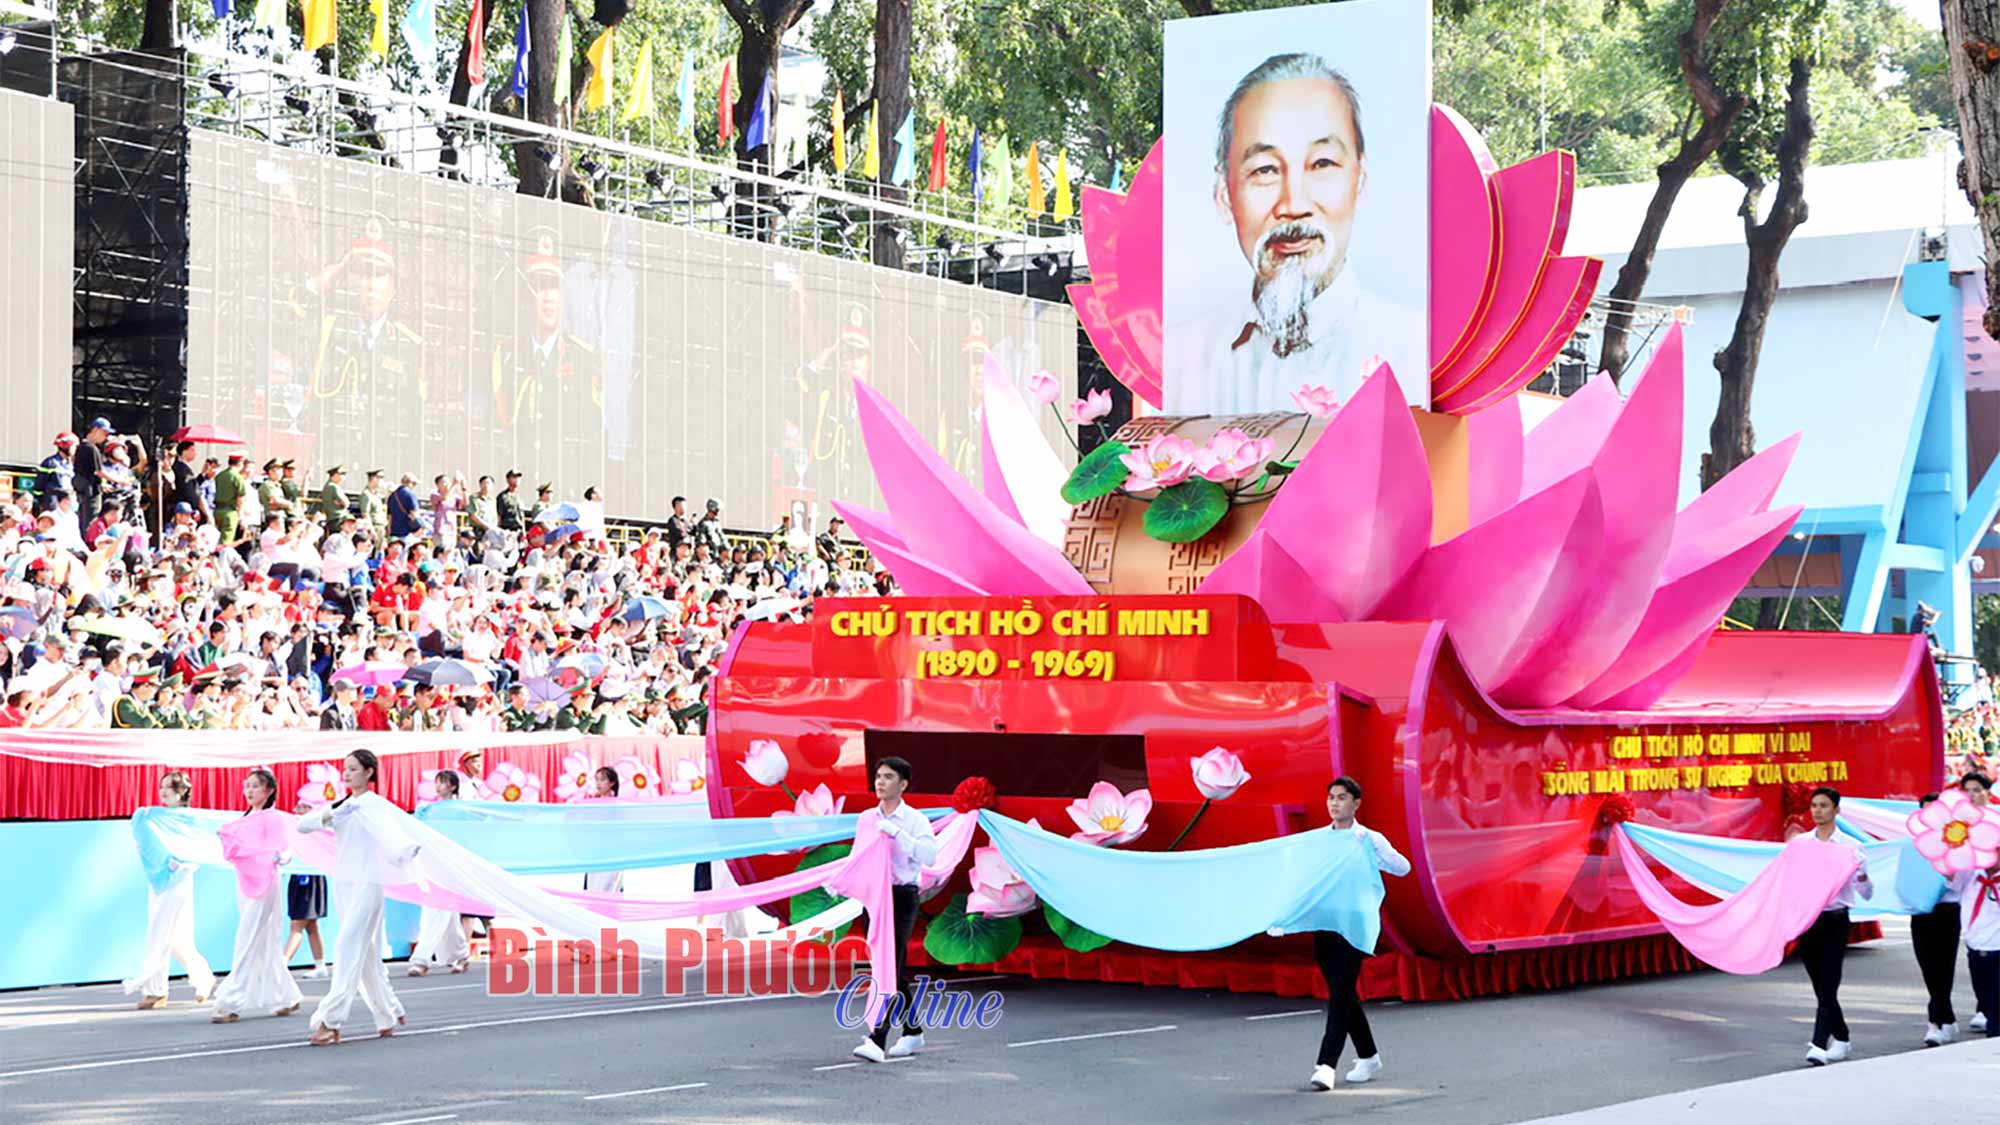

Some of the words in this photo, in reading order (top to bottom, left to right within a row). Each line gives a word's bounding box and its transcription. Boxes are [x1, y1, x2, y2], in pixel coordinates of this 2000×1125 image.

[830, 604, 897, 637] CHỦ
[905, 610, 982, 642] TỊCH
[989, 599, 1043, 637] HỒ
[1051, 602, 1109, 637] CHÍ
[1118, 609, 1210, 636] MINH
[916, 649, 998, 679] (1890
[1007, 659, 1021, 669] -
[1031, 650, 1115, 681] 1969)
[1732, 733, 1765, 754] MINH
[1629, 768, 1679, 791] TRONG
[1830, 761, 1848, 781] TA
